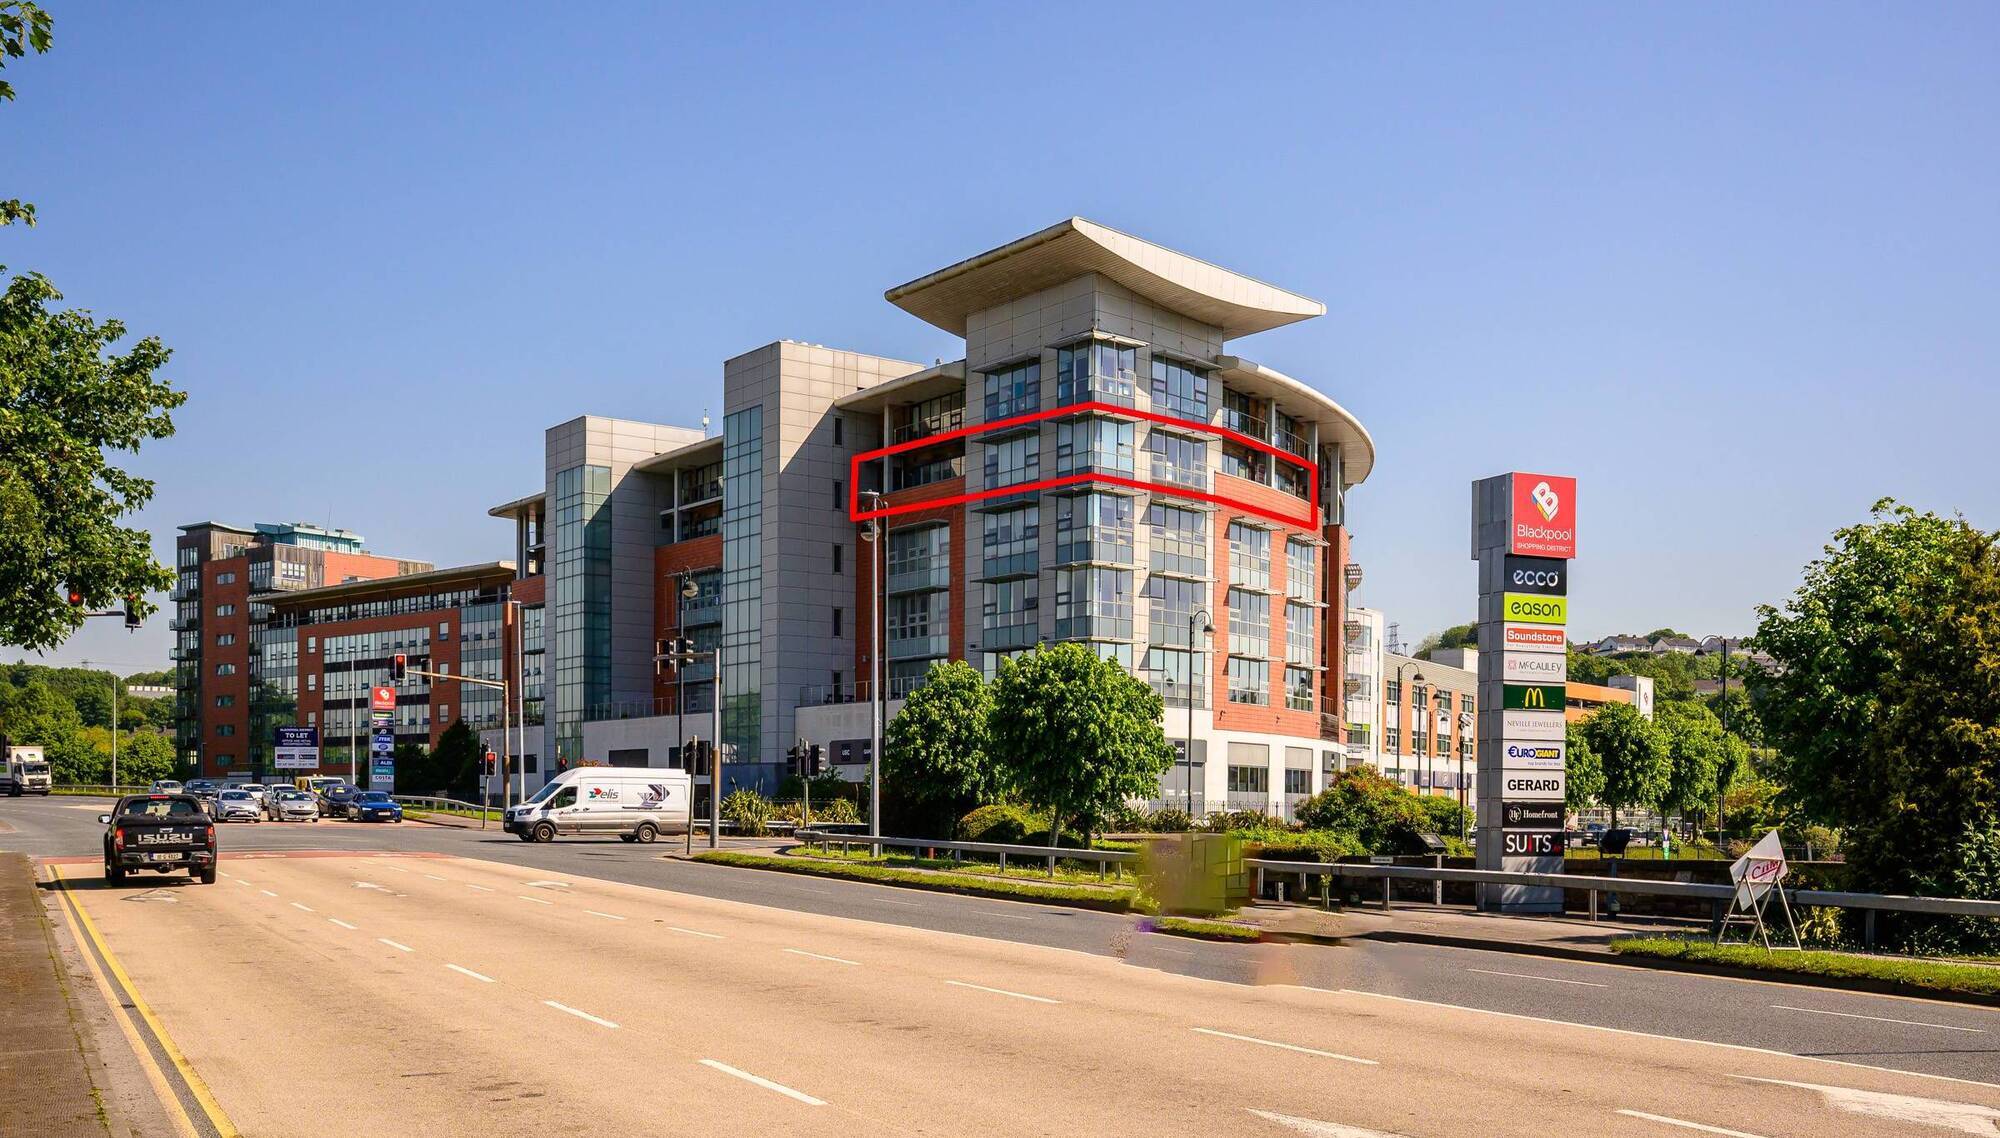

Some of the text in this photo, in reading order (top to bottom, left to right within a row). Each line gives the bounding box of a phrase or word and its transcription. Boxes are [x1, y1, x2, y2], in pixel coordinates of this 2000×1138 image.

[1517, 524, 1572, 541] Blackpool
[1517, 542, 1572, 552] SHOPPING DISTRICT
[1513, 570, 1558, 587] ecco
[1511, 602, 1561, 616] eason
[1507, 630, 1562, 642] Soundstore
[1532, 720, 1562, 728] JEWELLERS
[1508, 779, 1560, 791] GERARD
[600, 789, 619, 799] elis
[1523, 809, 1558, 818] Homefront
[138, 833, 193, 841] ISUZU
